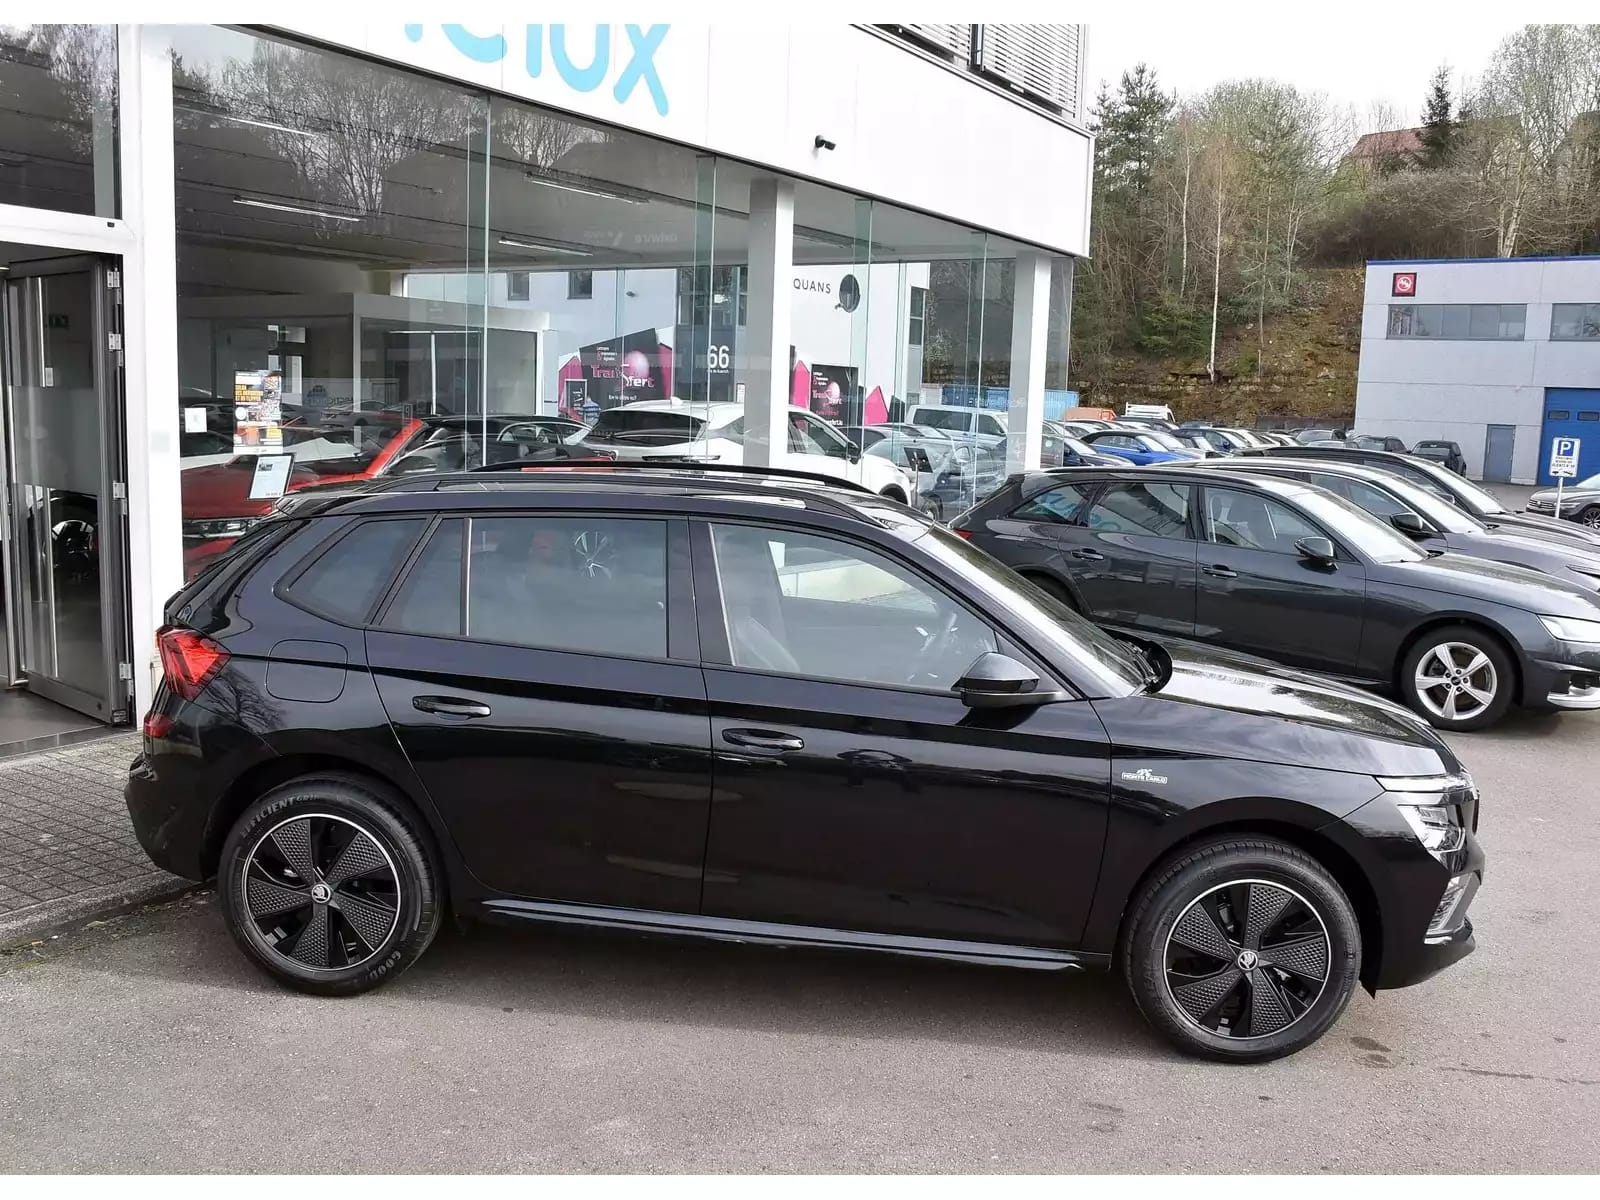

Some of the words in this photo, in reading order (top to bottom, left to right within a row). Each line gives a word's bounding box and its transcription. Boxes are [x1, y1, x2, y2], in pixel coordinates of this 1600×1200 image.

[793, 278, 831, 294] QUANS
[707, 345, 730, 369] 66
[1560, 441, 1571, 456] P
